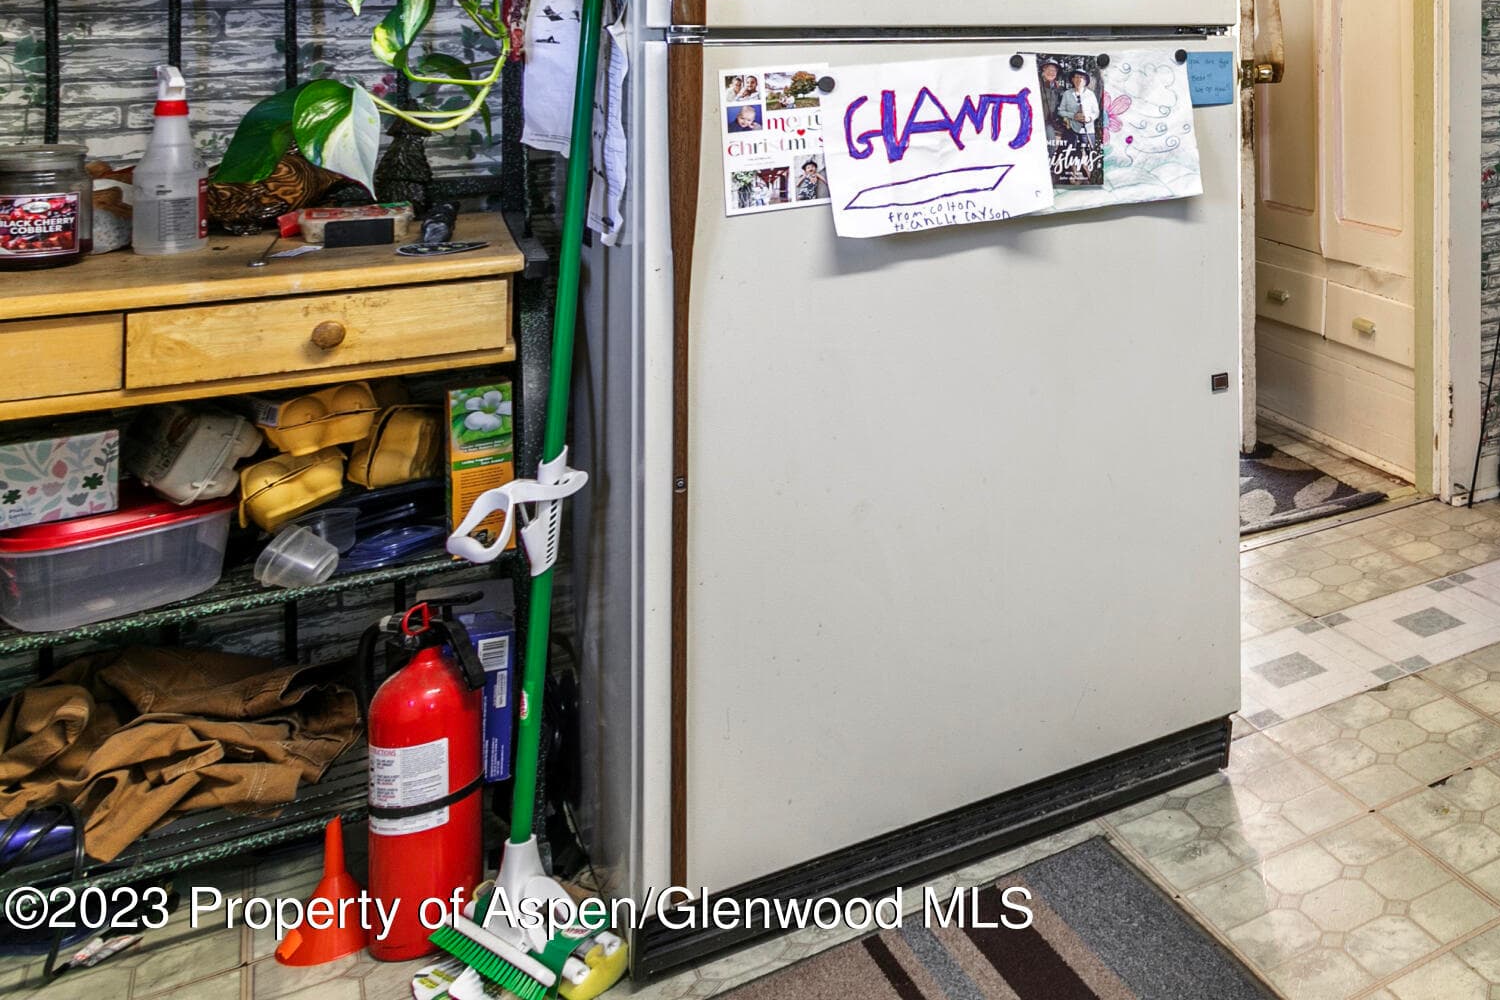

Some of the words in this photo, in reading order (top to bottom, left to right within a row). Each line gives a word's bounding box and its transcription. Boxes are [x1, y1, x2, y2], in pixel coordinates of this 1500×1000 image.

[844, 86, 1033, 164] GIANTS
[34, 217, 74, 226] CHERRY
[10, 224, 62, 235] COBBLER
